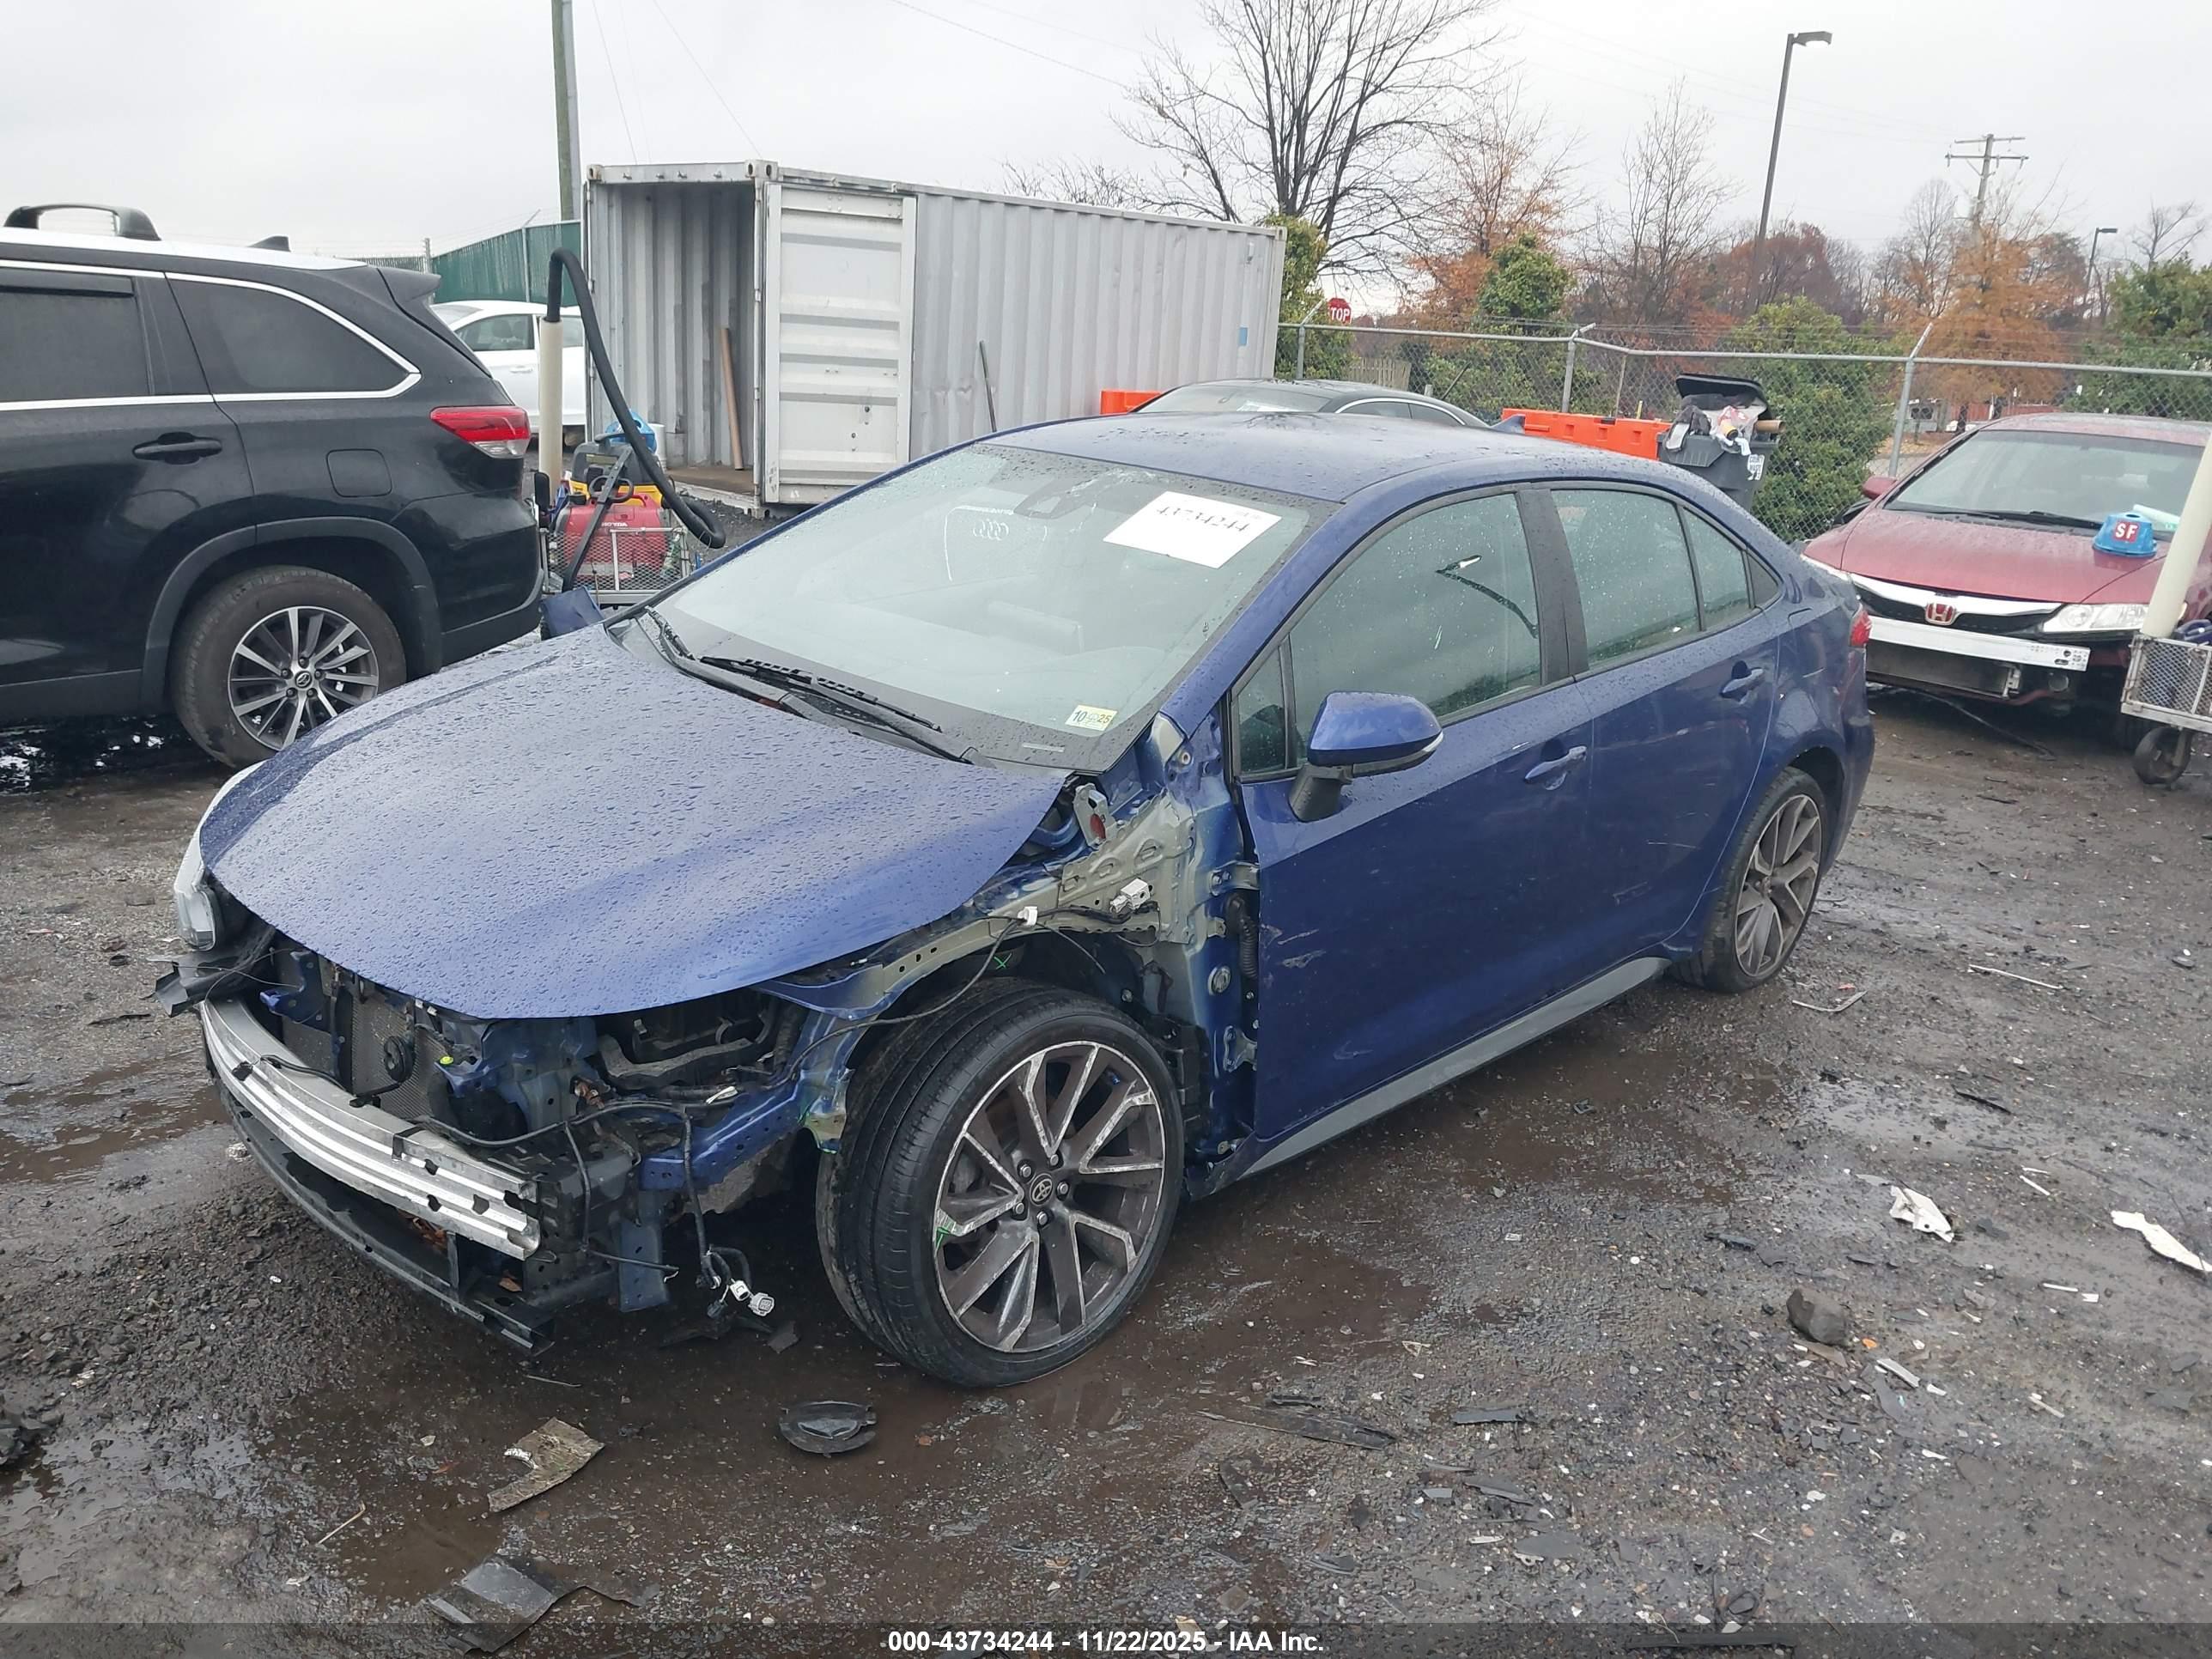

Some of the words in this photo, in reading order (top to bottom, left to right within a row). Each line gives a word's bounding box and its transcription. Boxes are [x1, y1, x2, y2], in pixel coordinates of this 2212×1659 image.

[1329, 307, 1350, 321] TOP
[2115, 522, 2138, 539] SF
[1073, 709, 1088, 722] 10
[1097, 714, 1113, 724] 25
